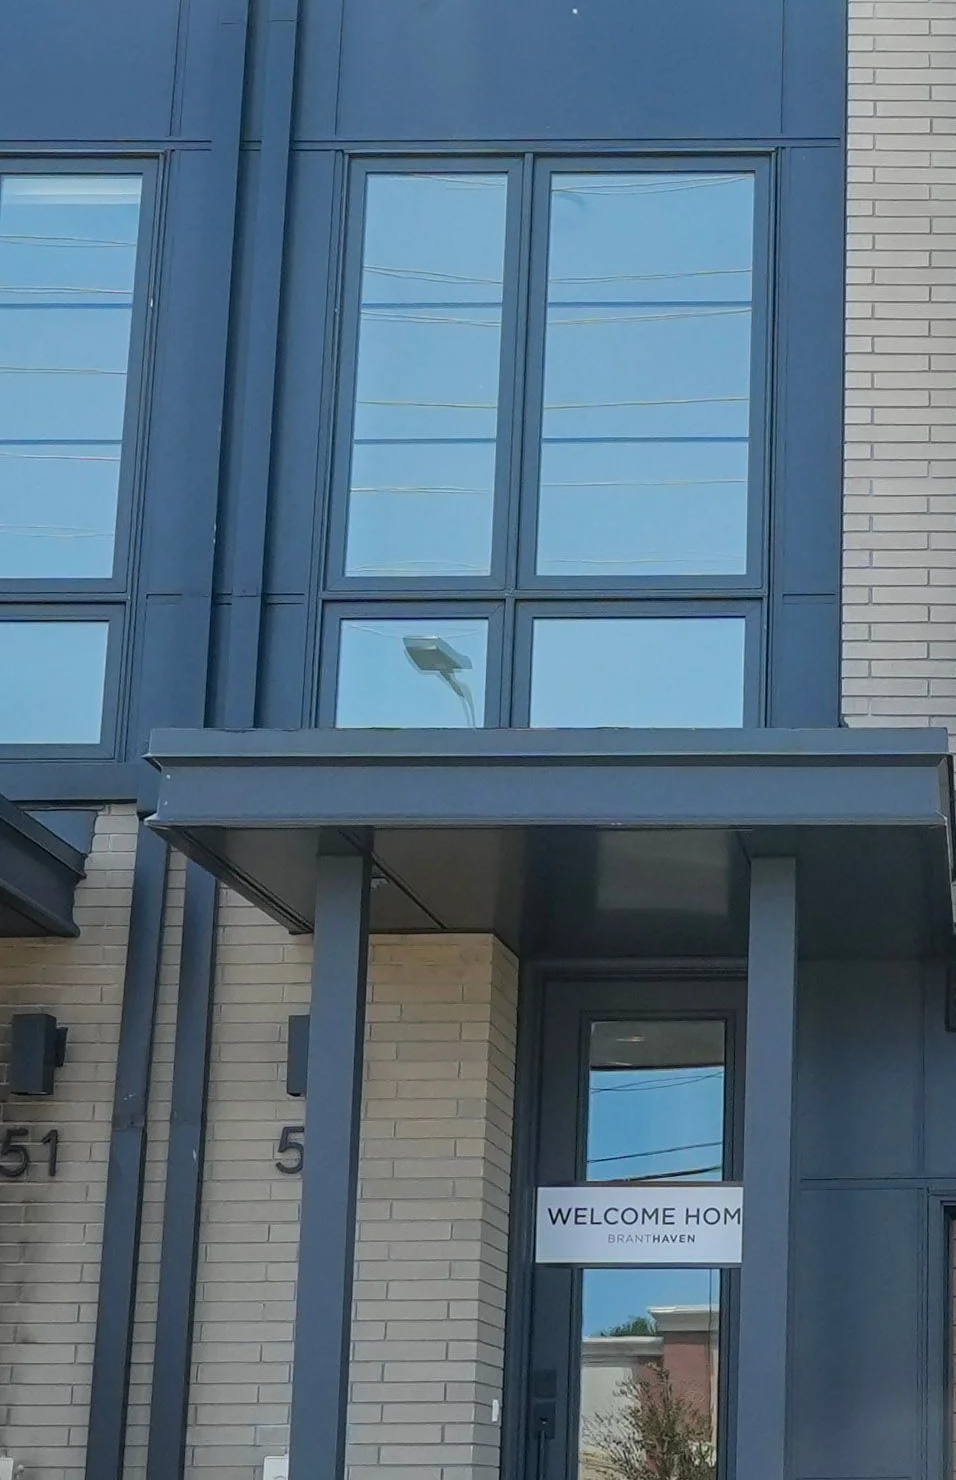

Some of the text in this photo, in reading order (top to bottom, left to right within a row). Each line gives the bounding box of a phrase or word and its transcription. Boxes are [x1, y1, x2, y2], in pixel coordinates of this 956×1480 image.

[0, 1128, 58, 1177] 51
[548, 1207, 741, 1226] WELCOME HOM
[607, 1234, 696, 1244] BRANTHAVEN
